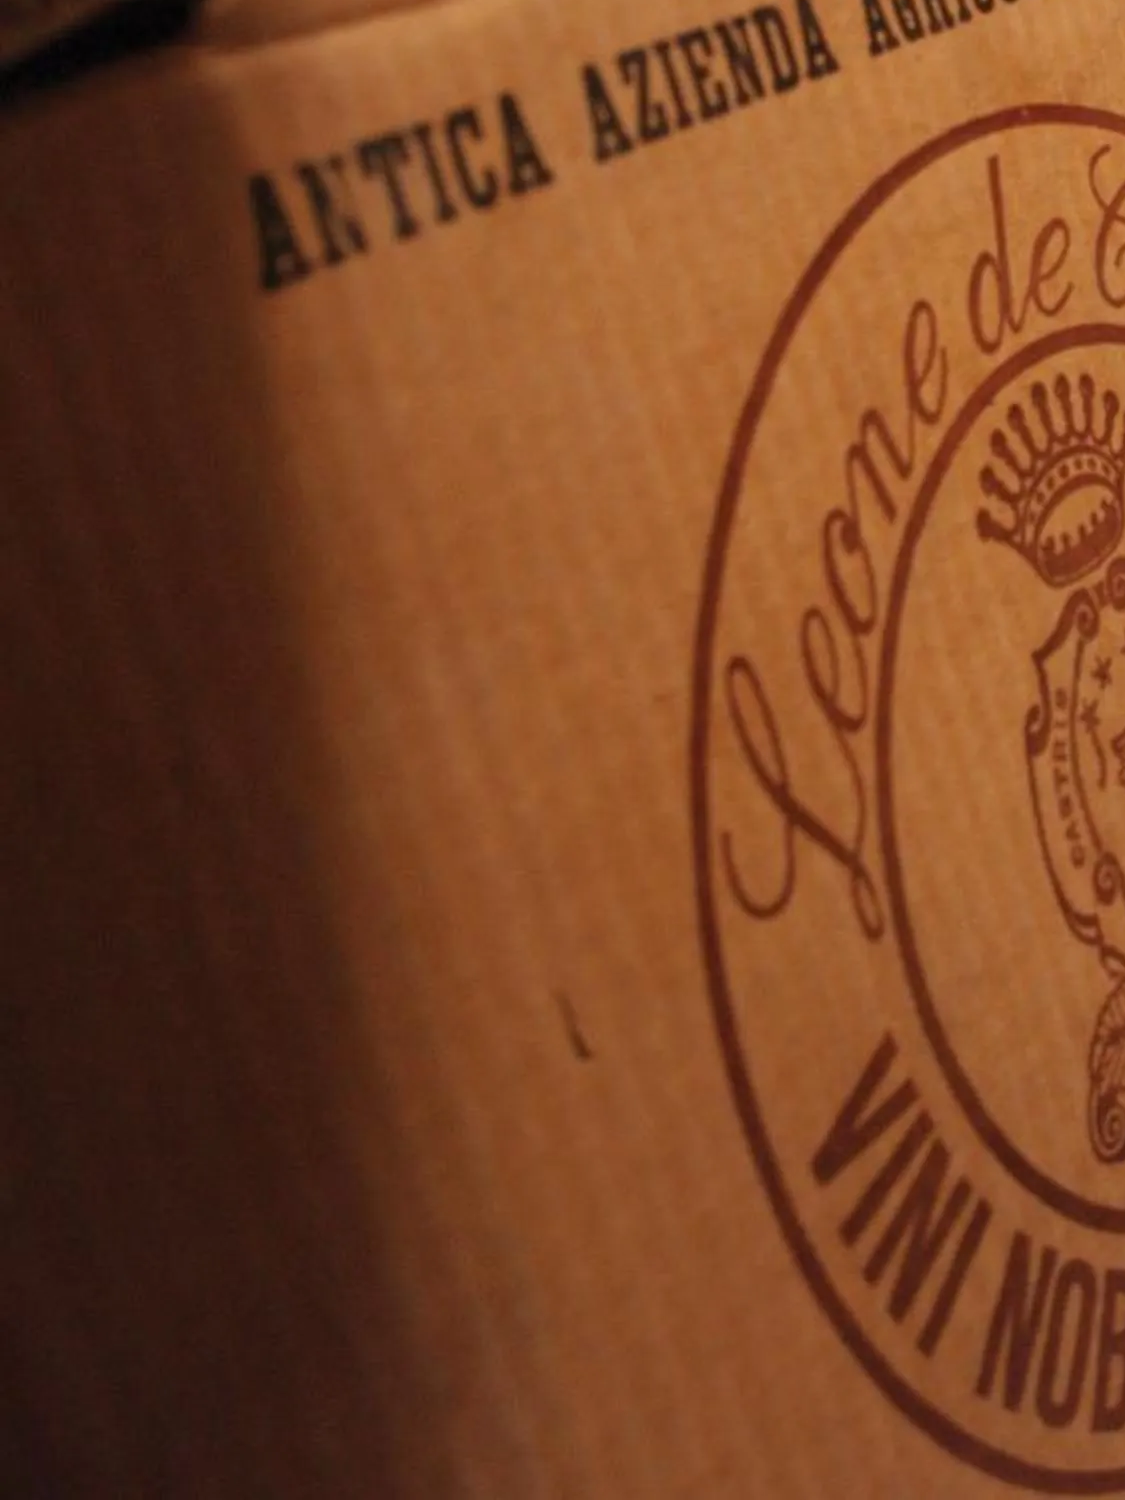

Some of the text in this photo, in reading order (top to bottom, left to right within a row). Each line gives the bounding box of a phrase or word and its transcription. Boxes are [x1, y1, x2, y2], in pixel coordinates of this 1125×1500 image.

[245, 92, 557, 290] ANTICA
[723, 298, 949, 943] Leone
[969, 153, 1074, 355] de
[810, 1032, 993, 1358] VINI
